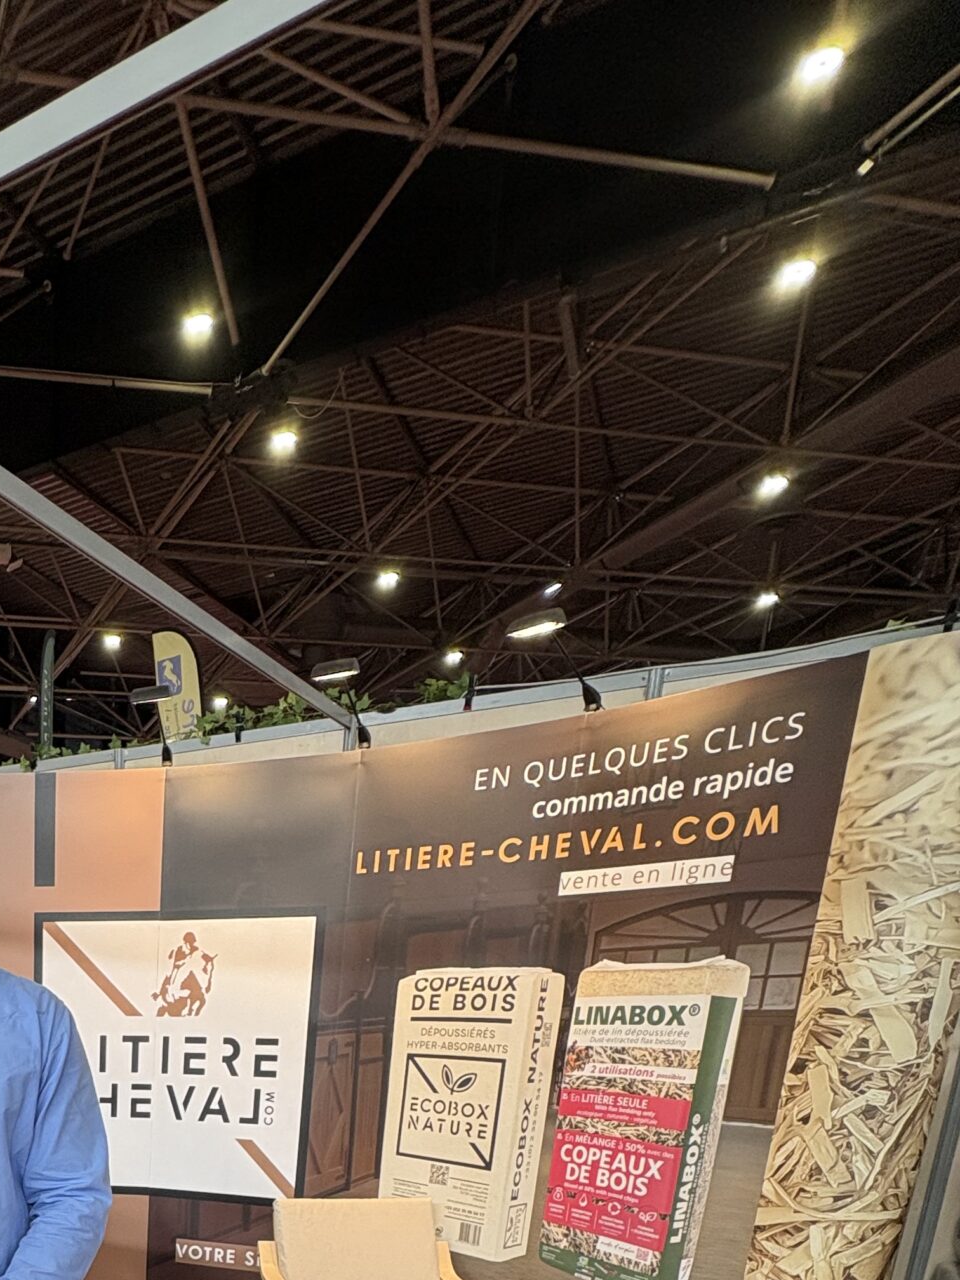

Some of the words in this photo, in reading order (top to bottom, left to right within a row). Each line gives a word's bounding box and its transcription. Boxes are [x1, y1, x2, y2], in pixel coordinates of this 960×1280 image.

[474, 765, 512, 792] EN
[523, 734, 690, 788] QUELQUES
[703, 711, 806, 756] CLICS
[532, 775, 685, 820] commande
[692, 757, 795, 804] rapide
[355, 805, 780, 876] LITIERE-CHEVAL.COM
[560, 863, 622, 892] vente
[632, 867, 660, 886] en
[670, 856, 734, 886] ligne
[414, 975, 520, 992] COPEAUX
[411, 994, 442, 1011] DE
[452, 993, 516, 1012] BOIS
[573, 1003, 701, 1026] LINABOX®
[420, 1026, 496, 1040] DÉPOUSSIÉRÉS
[598, 1028, 610, 1036] de
[612, 1028, 623, 1036] lin
[99, 1035, 280, 1078] ITIERE
[406, 1040, 510, 1054] HYPER-ABSORBANTS
[590, 1065, 598, 1074] 2
[598, 1066, 656, 1078] utilisations
[510, 1098, 533, 1202] ECOBOX
[527, 978, 550, 1084] NATURE
[581, 1090, 616, 1106] LITIÈRE
[616, 1097, 649, 1110] SEULE
[99, 1083, 262, 1124] HEVAL
[264, 1091, 276, 1126] COM
[410, 1097, 490, 1121] ECOBOX
[408, 1114, 488, 1140] NATURE
[575, 1134, 617, 1148] MÉLANGE
[625, 1142, 646, 1154] 50%
[560, 1143, 664, 1180] COPEAUX
[565, 1162, 592, 1184] DE
[595, 1168, 649, 1196] BOIS
[175, 1243, 235, 1264] VOTRE
